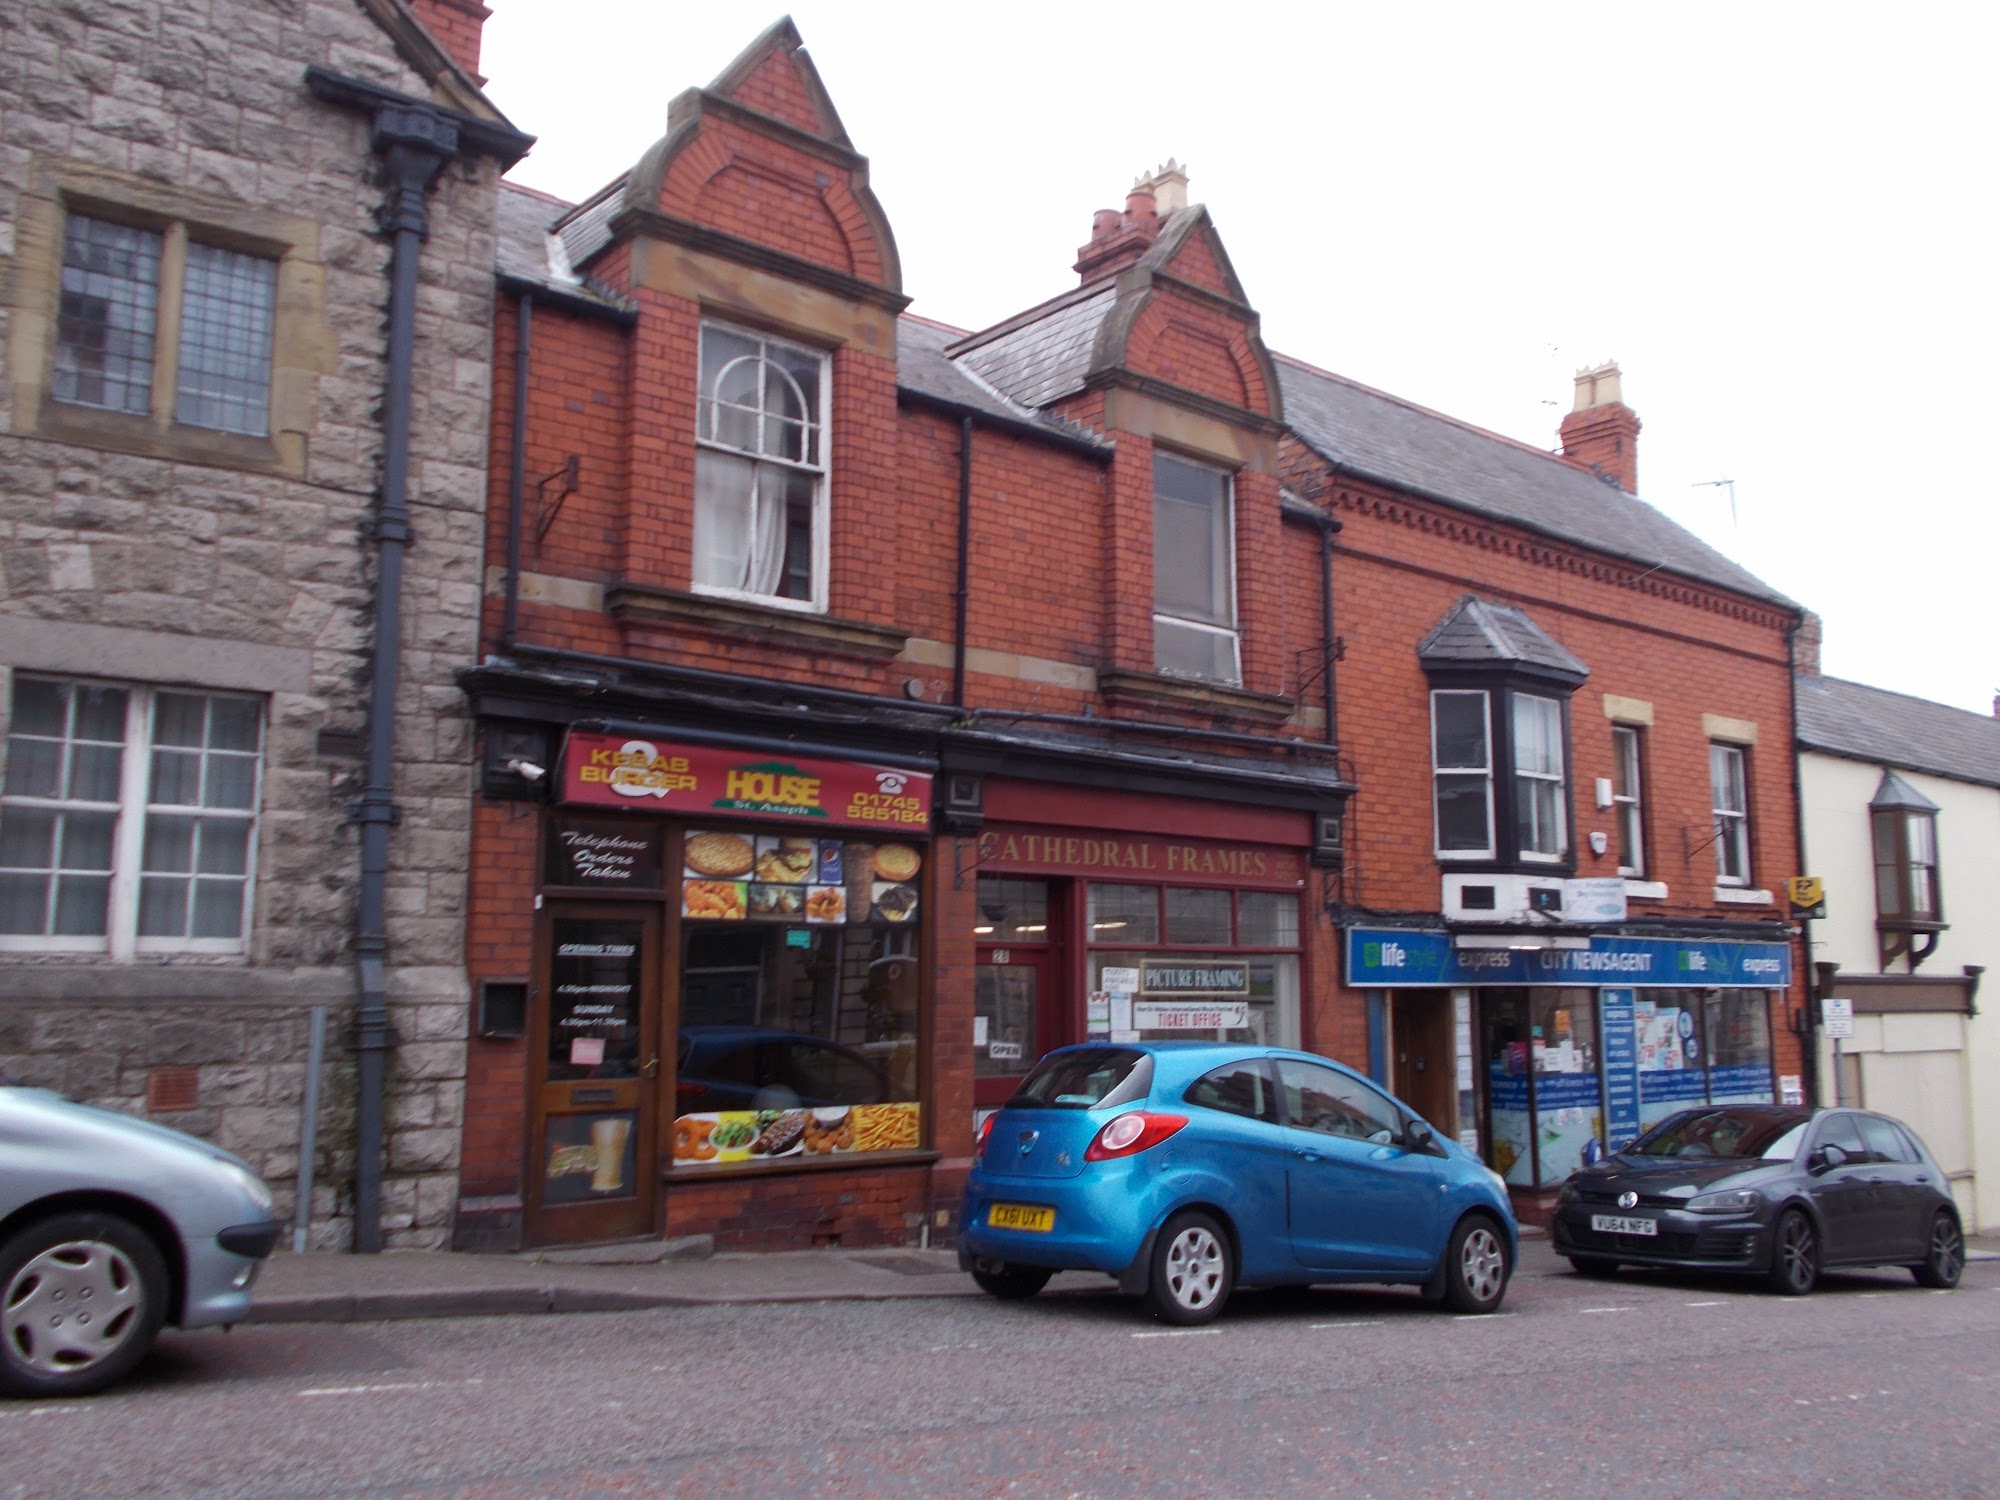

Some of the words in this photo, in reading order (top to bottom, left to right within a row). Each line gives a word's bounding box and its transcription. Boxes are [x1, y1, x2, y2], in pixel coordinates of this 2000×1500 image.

[591, 749, 689, 773] KEBAB
[580, 766, 698, 791] BURGER
[726, 770, 820, 807] HOUSE
[760, 802, 809, 816] Asaph
[853, 792, 920, 809] 01745
[847, 805, 929, 824] 585184
[560, 831, 649, 850] Telephone
[573, 849, 635, 865] Orders
[979, 832, 1157, 869] CATHEDRAL
[1167, 845, 1268, 877] FRAMES
[576, 862, 632, 879] Taken
[605, 944, 637, 956] TIMES
[1458, 951, 1511, 972] express
[1540, 950, 1571, 970] CITY
[1573, 951, 1653, 971] NEWSAGENT
[1145, 968, 1194, 987] PICTURE
[1194, 969, 1245, 987] FRAMING
[573, 1004, 616, 1014] SUNDAY
[1157, 1012, 1189, 1027] TICKET
[1192, 1012, 1222, 1027] OFFICE
[992, 1045, 1019, 1055] OPEN
[1022, 1209, 1047, 1228] UXT
